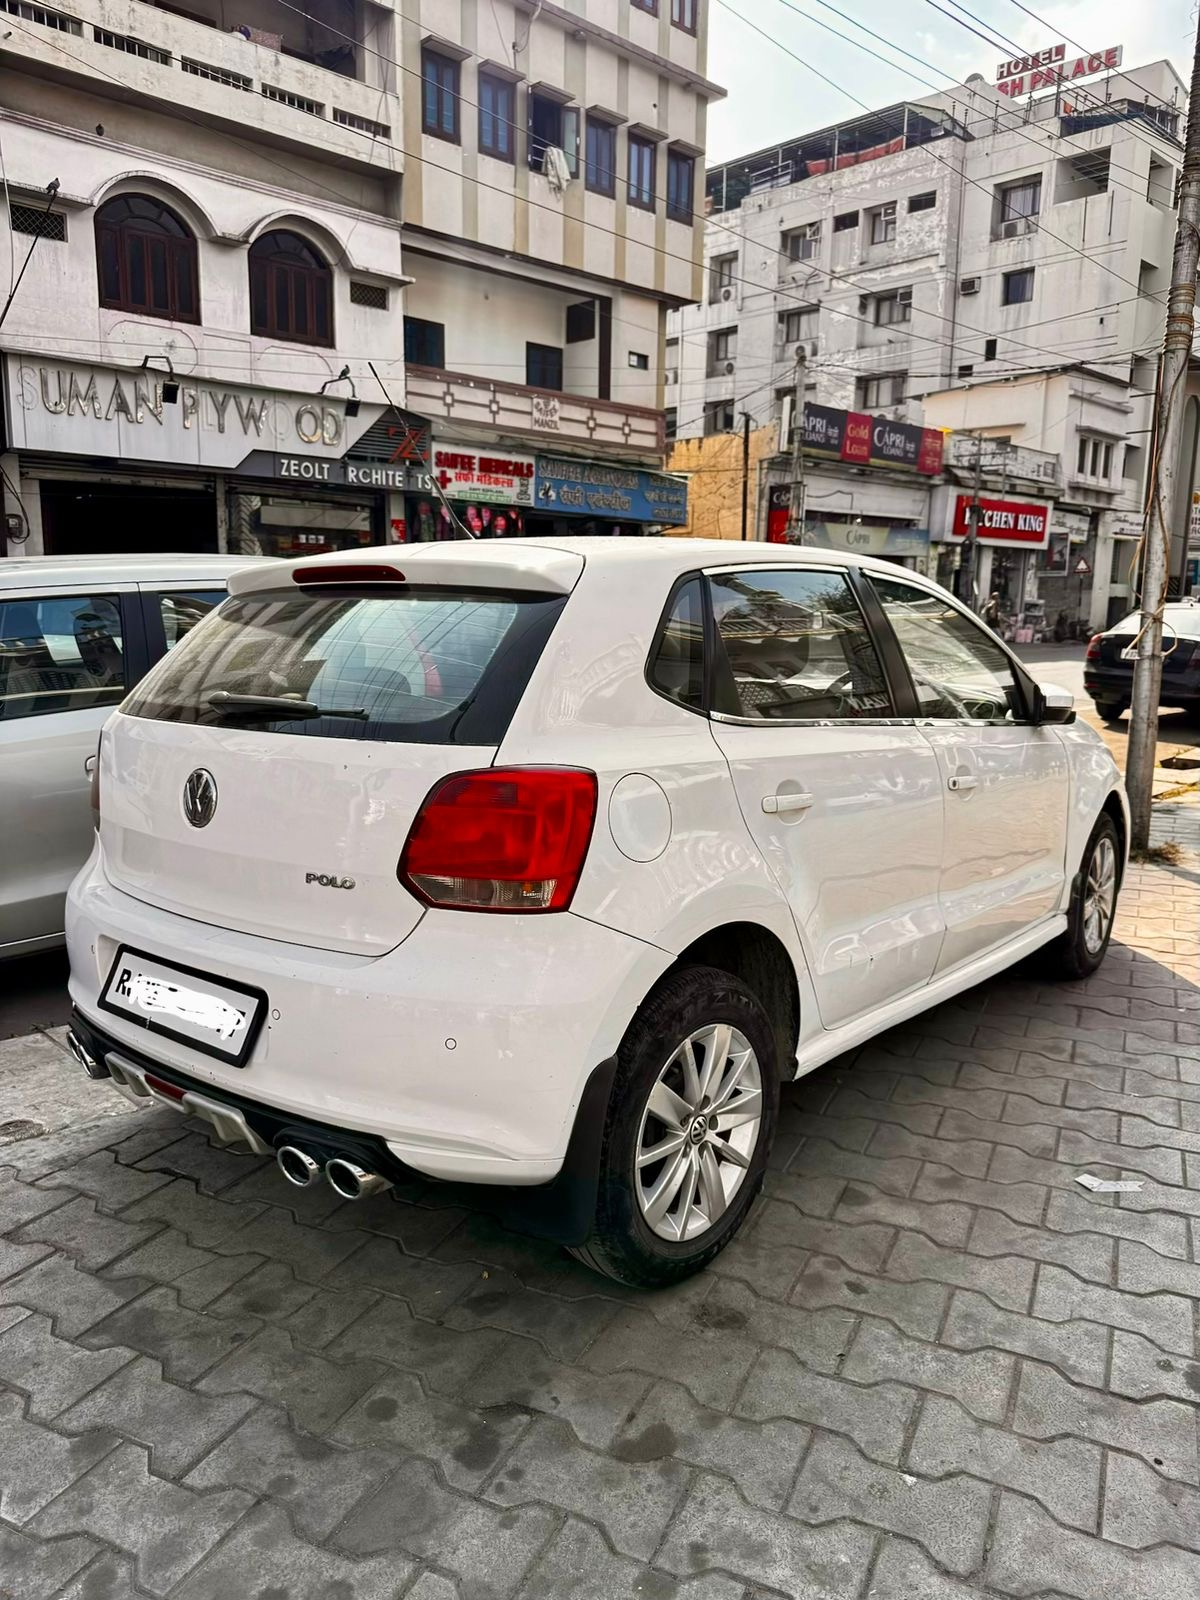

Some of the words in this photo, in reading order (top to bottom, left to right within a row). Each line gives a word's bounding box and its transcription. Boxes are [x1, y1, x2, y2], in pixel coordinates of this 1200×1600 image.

[998, 46, 1063, 78] HOTEL
[1030, 47, 1119, 91] PALACE
[847, 424, 869, 440] Gold
[846, 440, 868, 456] Loan
[280, 459, 330, 480] ZEOLT
[1017, 514, 1044, 532] KING
[305, 871, 356, 890] POLO
